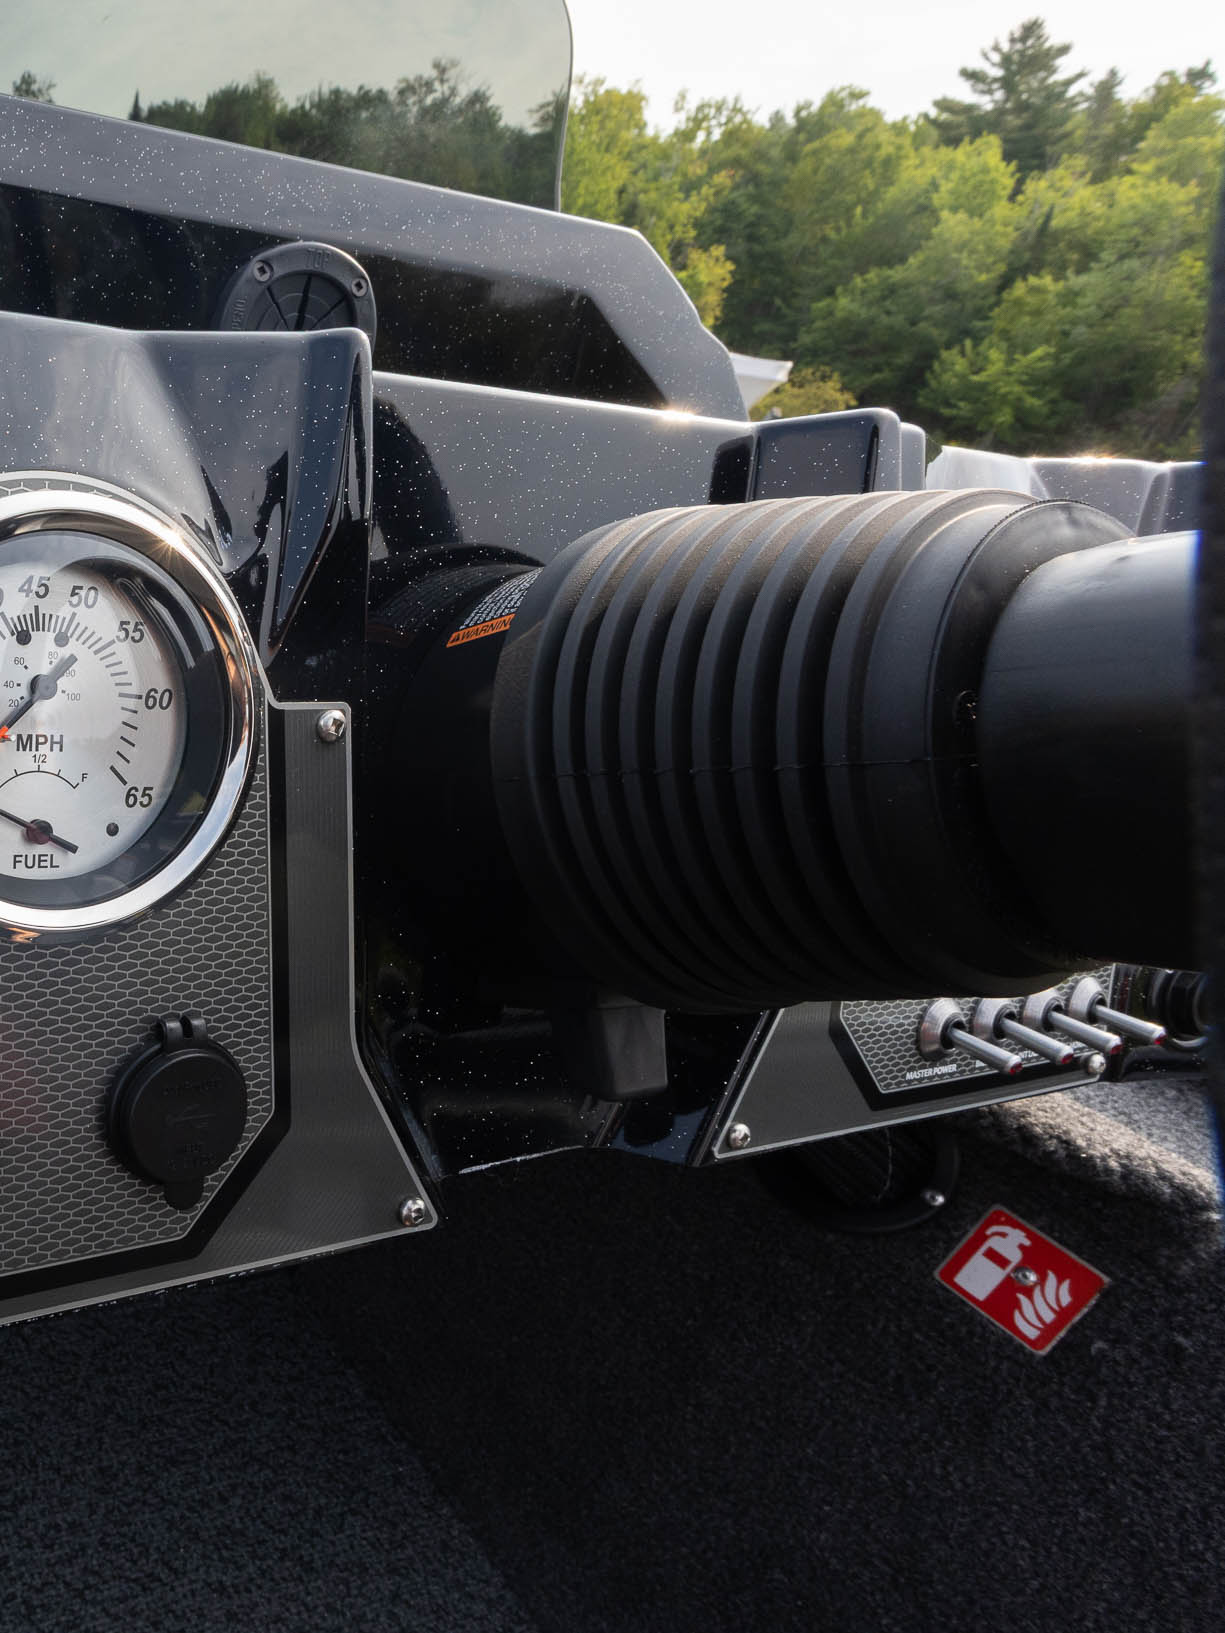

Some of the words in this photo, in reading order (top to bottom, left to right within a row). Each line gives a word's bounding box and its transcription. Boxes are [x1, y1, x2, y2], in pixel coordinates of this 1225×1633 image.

[18, 575, 51, 599] 45
[68, 585, 99, 609] 50
[115, 620, 145, 643] 55
[461, 618, 512, 641] WARNIN
[14, 657, 25, 666] 60
[48, 651, 59, 660] 80
[3, 680, 15, 689] 40
[8, 699, 20, 708] 20
[66, 693, 81, 702] 100
[144, 688, 173, 711] 60
[16, 733, 64, 752] MPH
[32, 753, 47, 764] 1/2
[81, 773, 88, 783] F
[125, 786, 154, 809] 65
[12, 853, 60, 870] FUEL
[905, 1067, 933, 1080] MASTER
[933, 1063, 957, 1076] POWER
